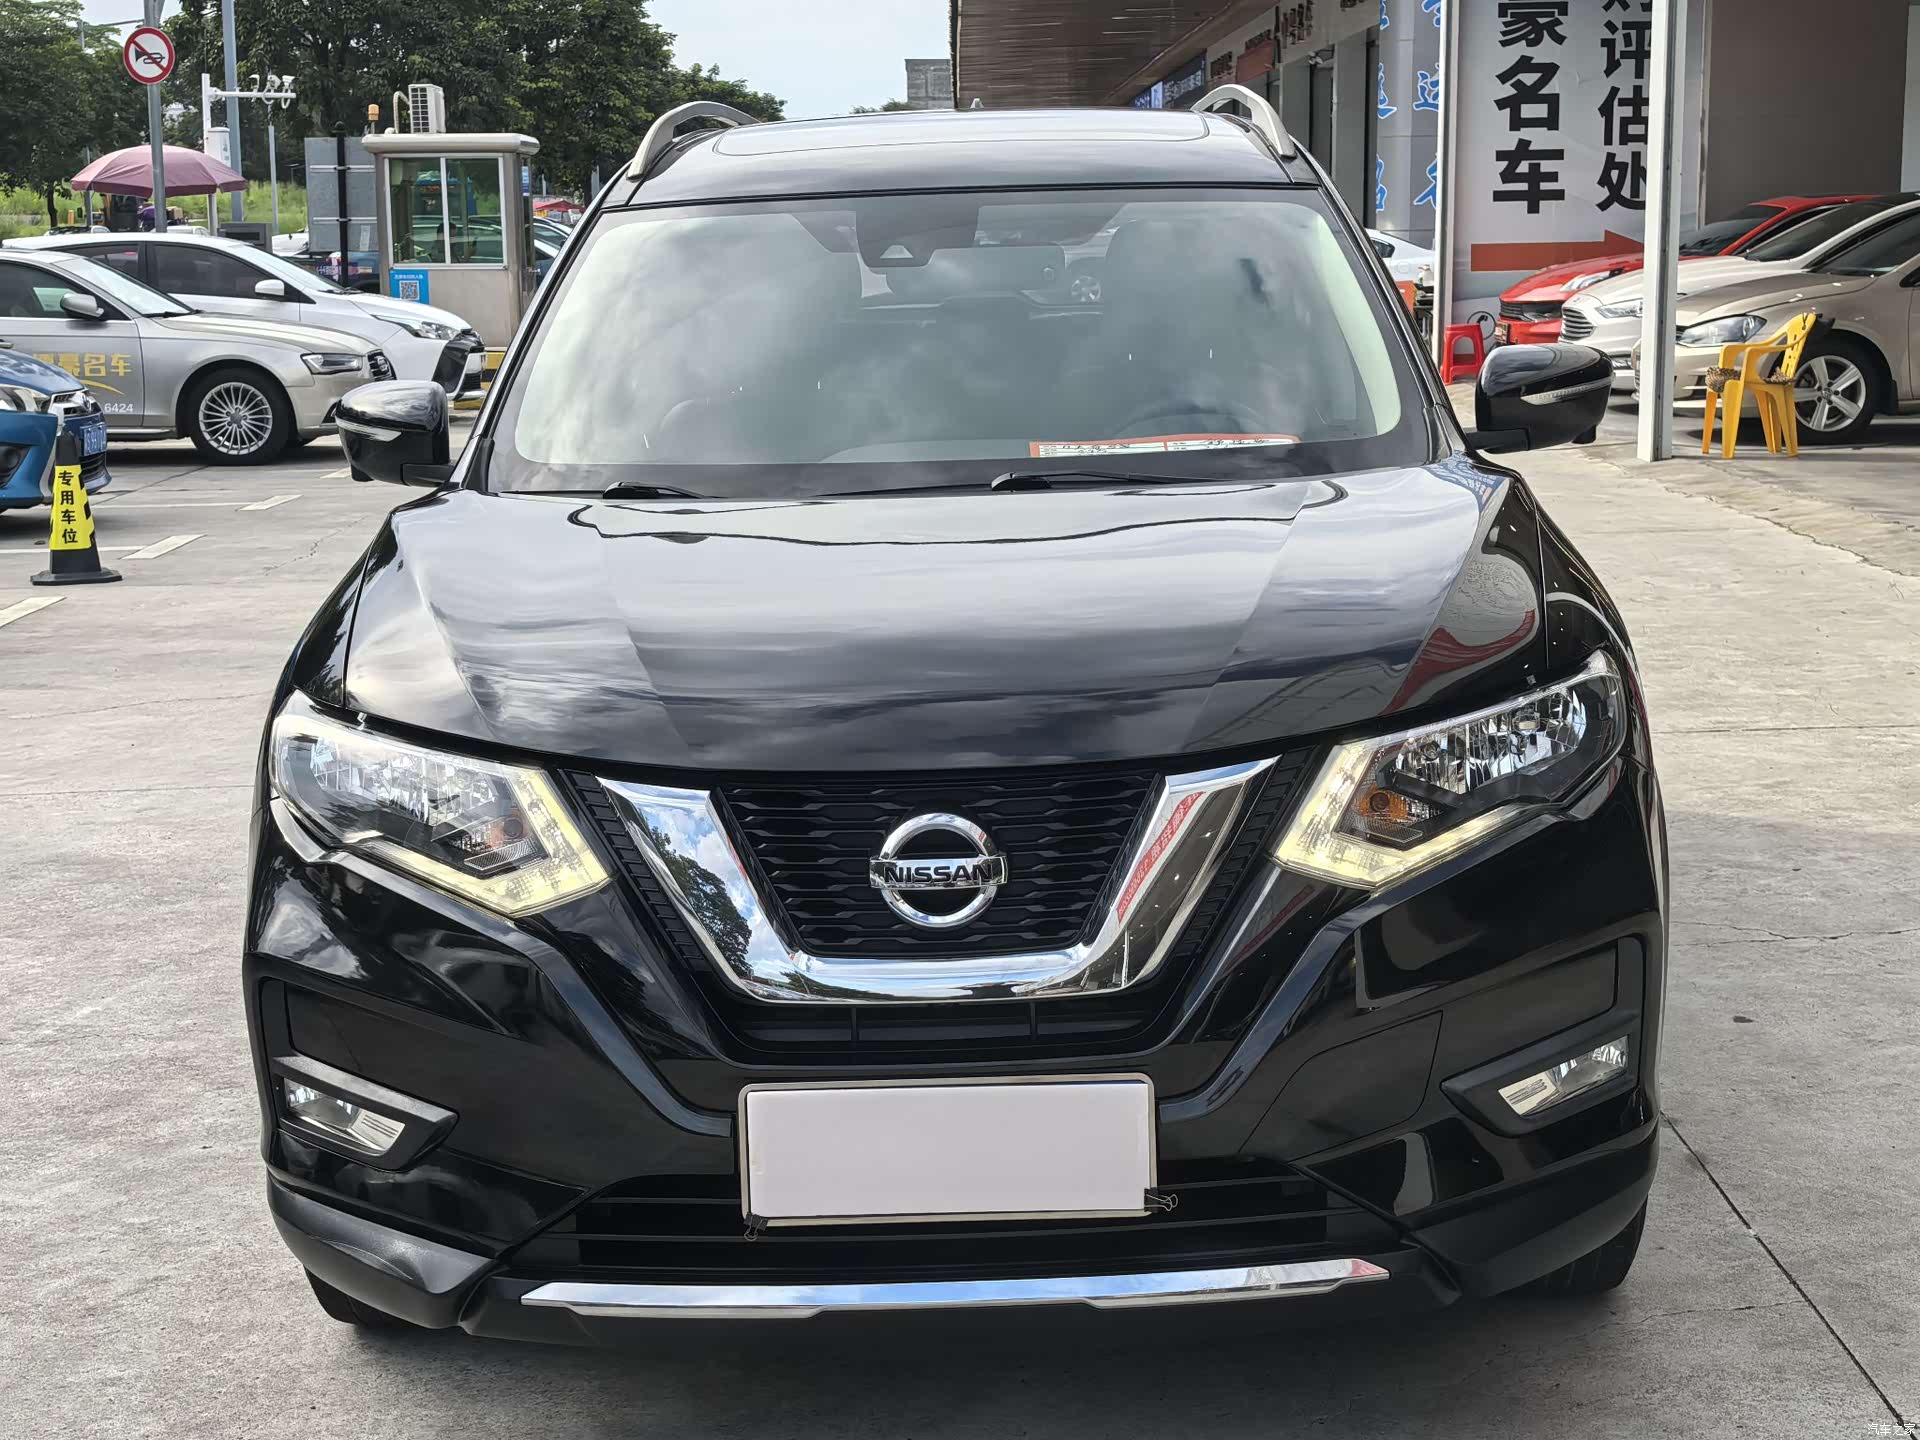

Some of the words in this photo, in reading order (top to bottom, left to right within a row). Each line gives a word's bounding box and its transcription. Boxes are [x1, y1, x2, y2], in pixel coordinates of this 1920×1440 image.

[1596, 0, 1652, 212] 评估处
[104, 403, 134, 413] 6424
[58, 470, 78, 544] 专用车位
[884, 864, 993, 883] NISSAN
